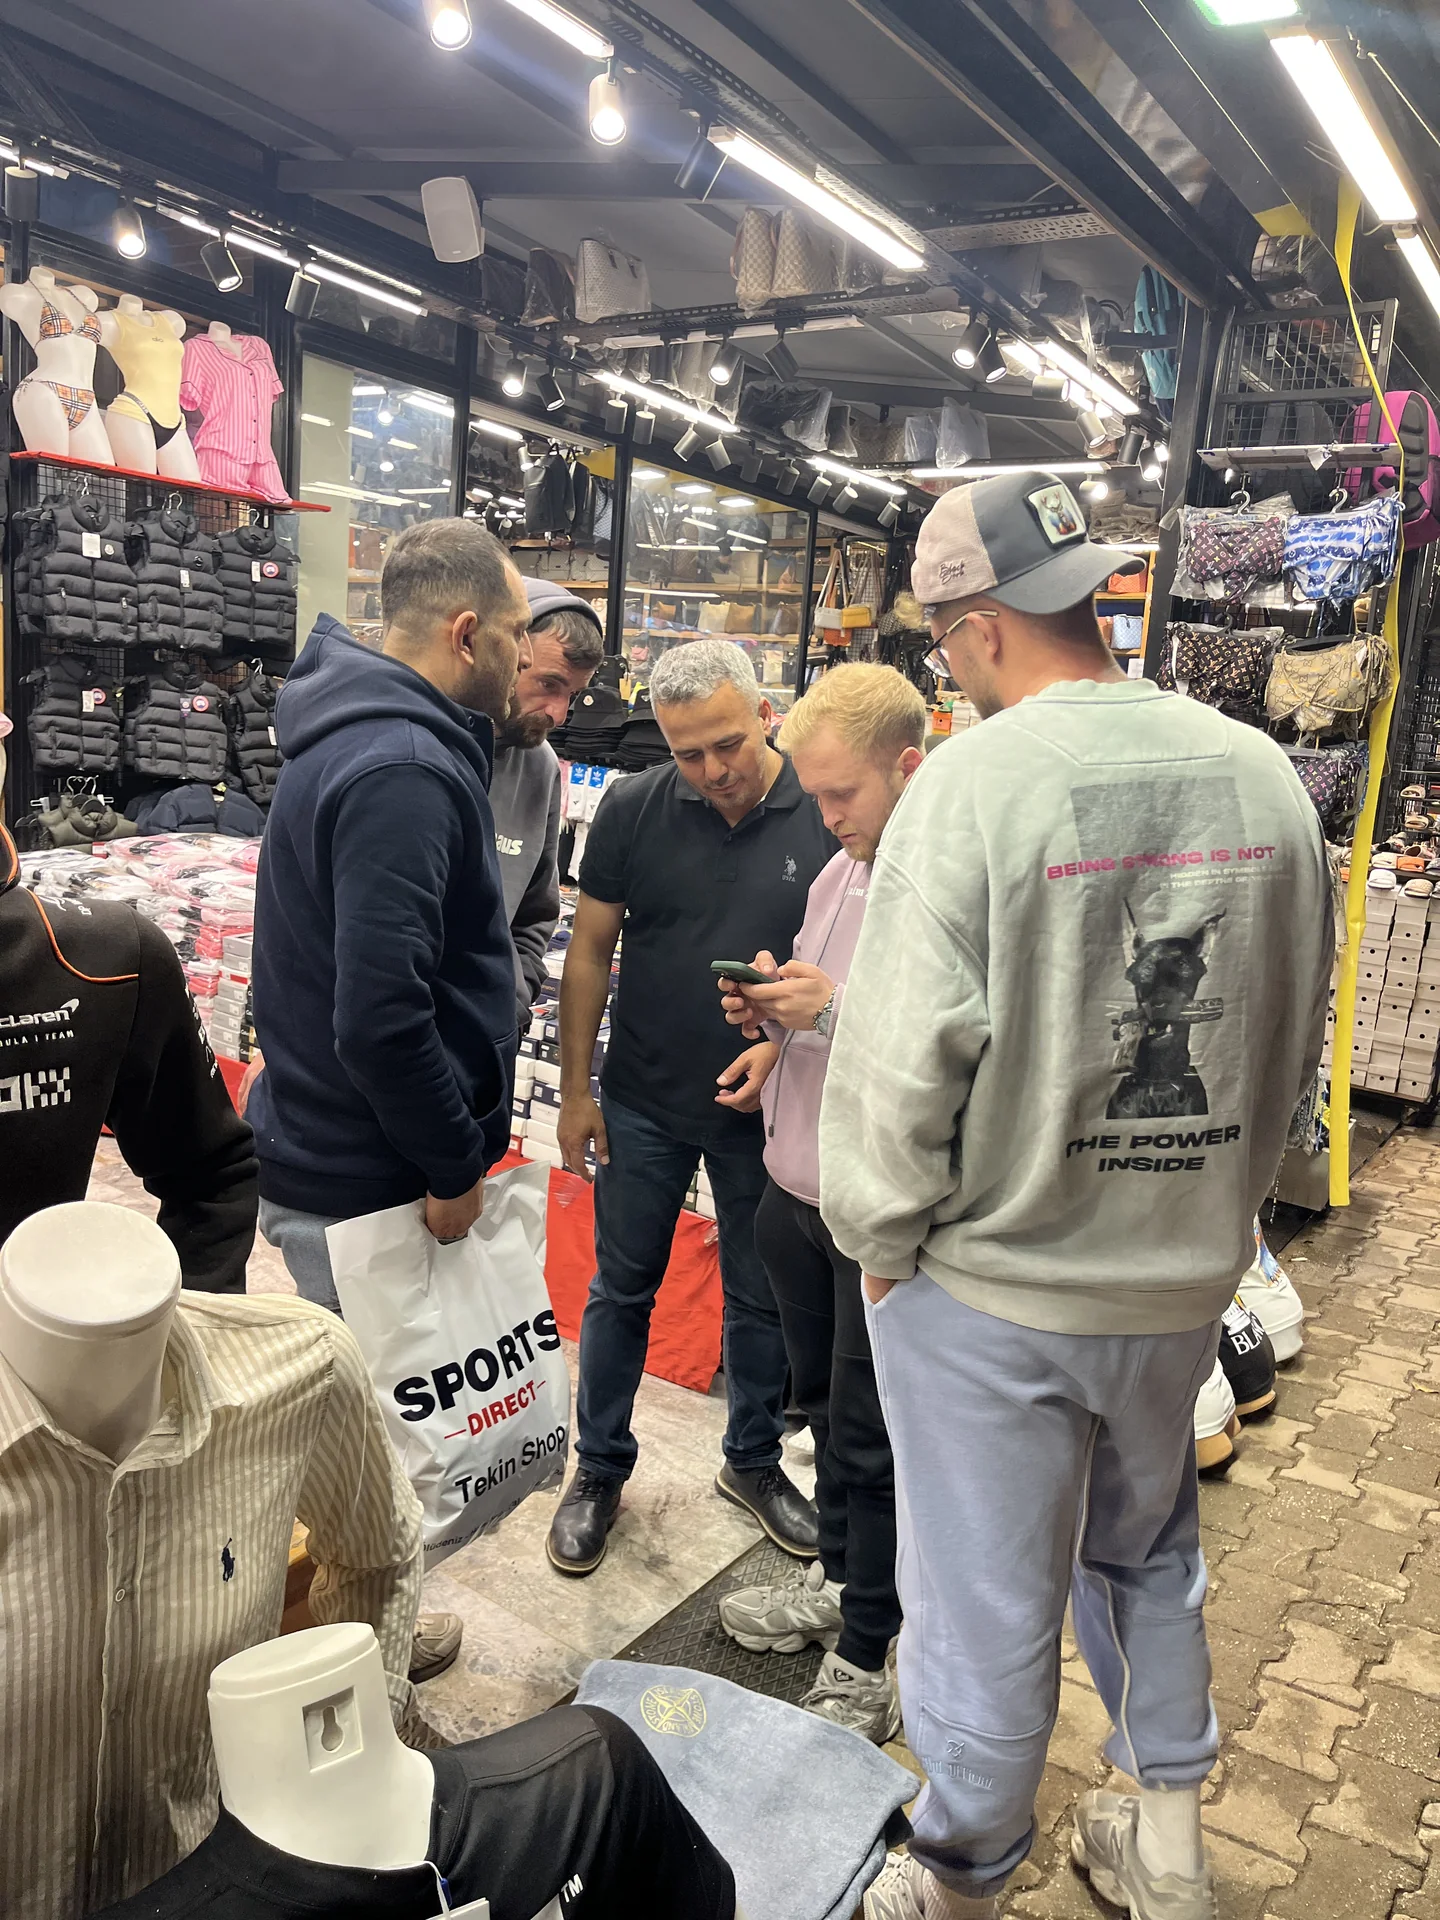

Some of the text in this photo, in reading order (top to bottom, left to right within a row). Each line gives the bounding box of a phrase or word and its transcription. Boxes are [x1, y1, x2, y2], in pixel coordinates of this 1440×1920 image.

[495, 833, 524, 856] aus
[1047, 857, 1116, 880] BEING
[1210, 848, 1231, 862] IS
[1237, 846, 1276, 862] NOT
[1170, 880, 1192, 889] THE
[45, 1029, 75, 1041] TEAM
[1066, 1124, 1241, 1159] THE POWER
[1098, 1156, 1206, 1173] INSIDE
[393, 1309, 562, 1422] SPORTS
[467, 1380, 536, 1437] DIRECT
[455, 1457, 516, 1504] Tekin
[521, 1426, 566, 1466] Shop
[644, 1697, 660, 1725] STONE
[690, 1694, 704, 1725] STONE
[560, 1873, 584, 1903] TM
